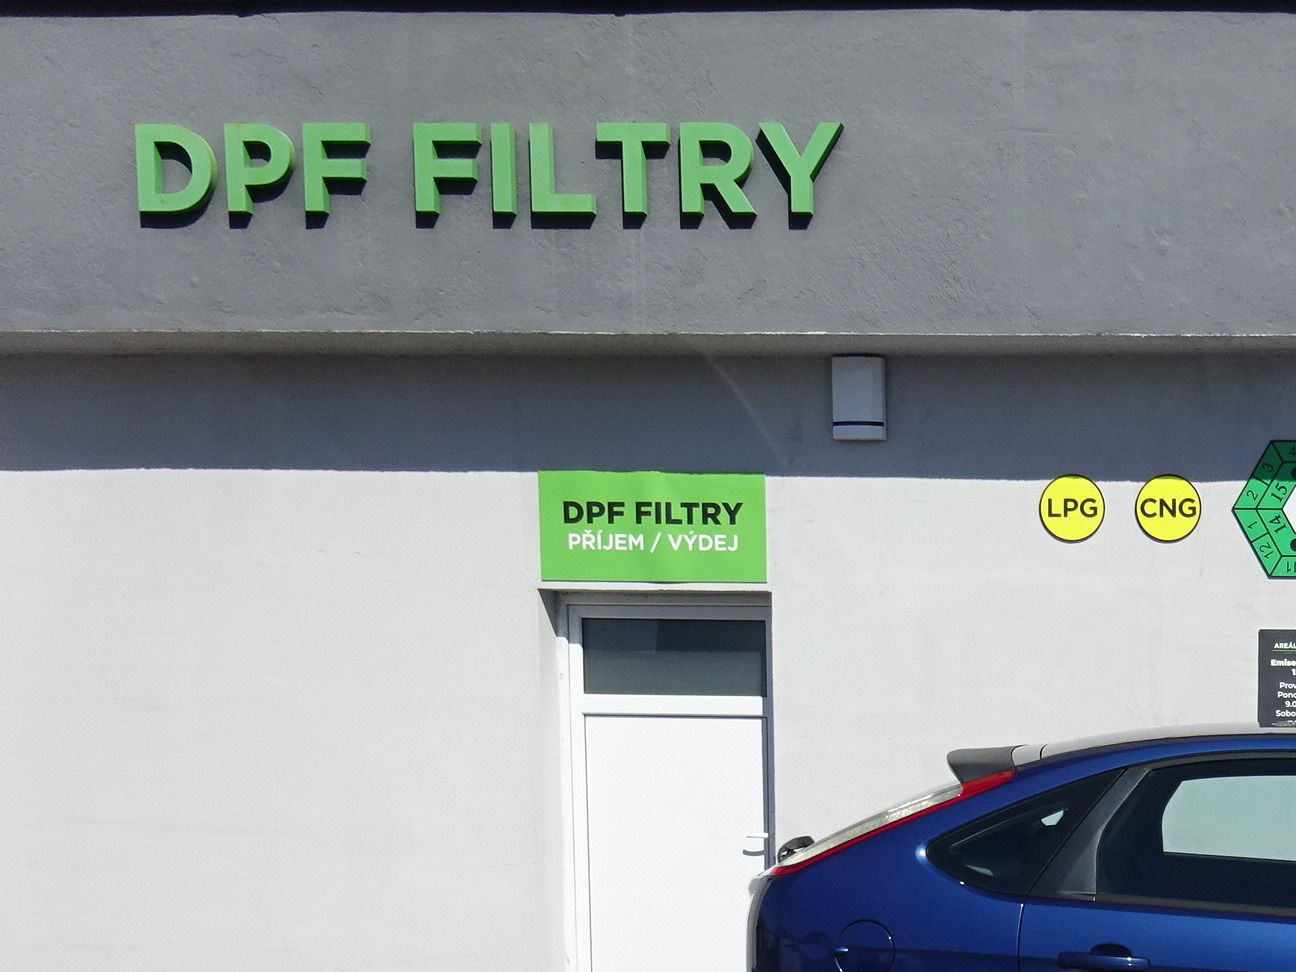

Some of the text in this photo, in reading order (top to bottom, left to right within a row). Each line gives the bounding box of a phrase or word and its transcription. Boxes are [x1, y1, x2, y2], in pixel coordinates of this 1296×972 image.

[134, 122, 844, 216] DPF FILTRY
[1289, 446, 1296, 457] 4
[1262, 462, 1274, 473] 3
[1246, 489, 1259, 501] 2
[1270, 482, 1288, 502] 15
[563, 501, 743, 525] DPF FILTRY
[1047, 498, 1098, 518] LPG
[1140, 498, 1197, 518] CNG
[1247, 520, 1258, 530] 1
[1269, 513, 1287, 534] 14
[568, 530, 738, 553] PŘÍJEM / VÝDEJ
[1259, 542, 1274, 559] 12
